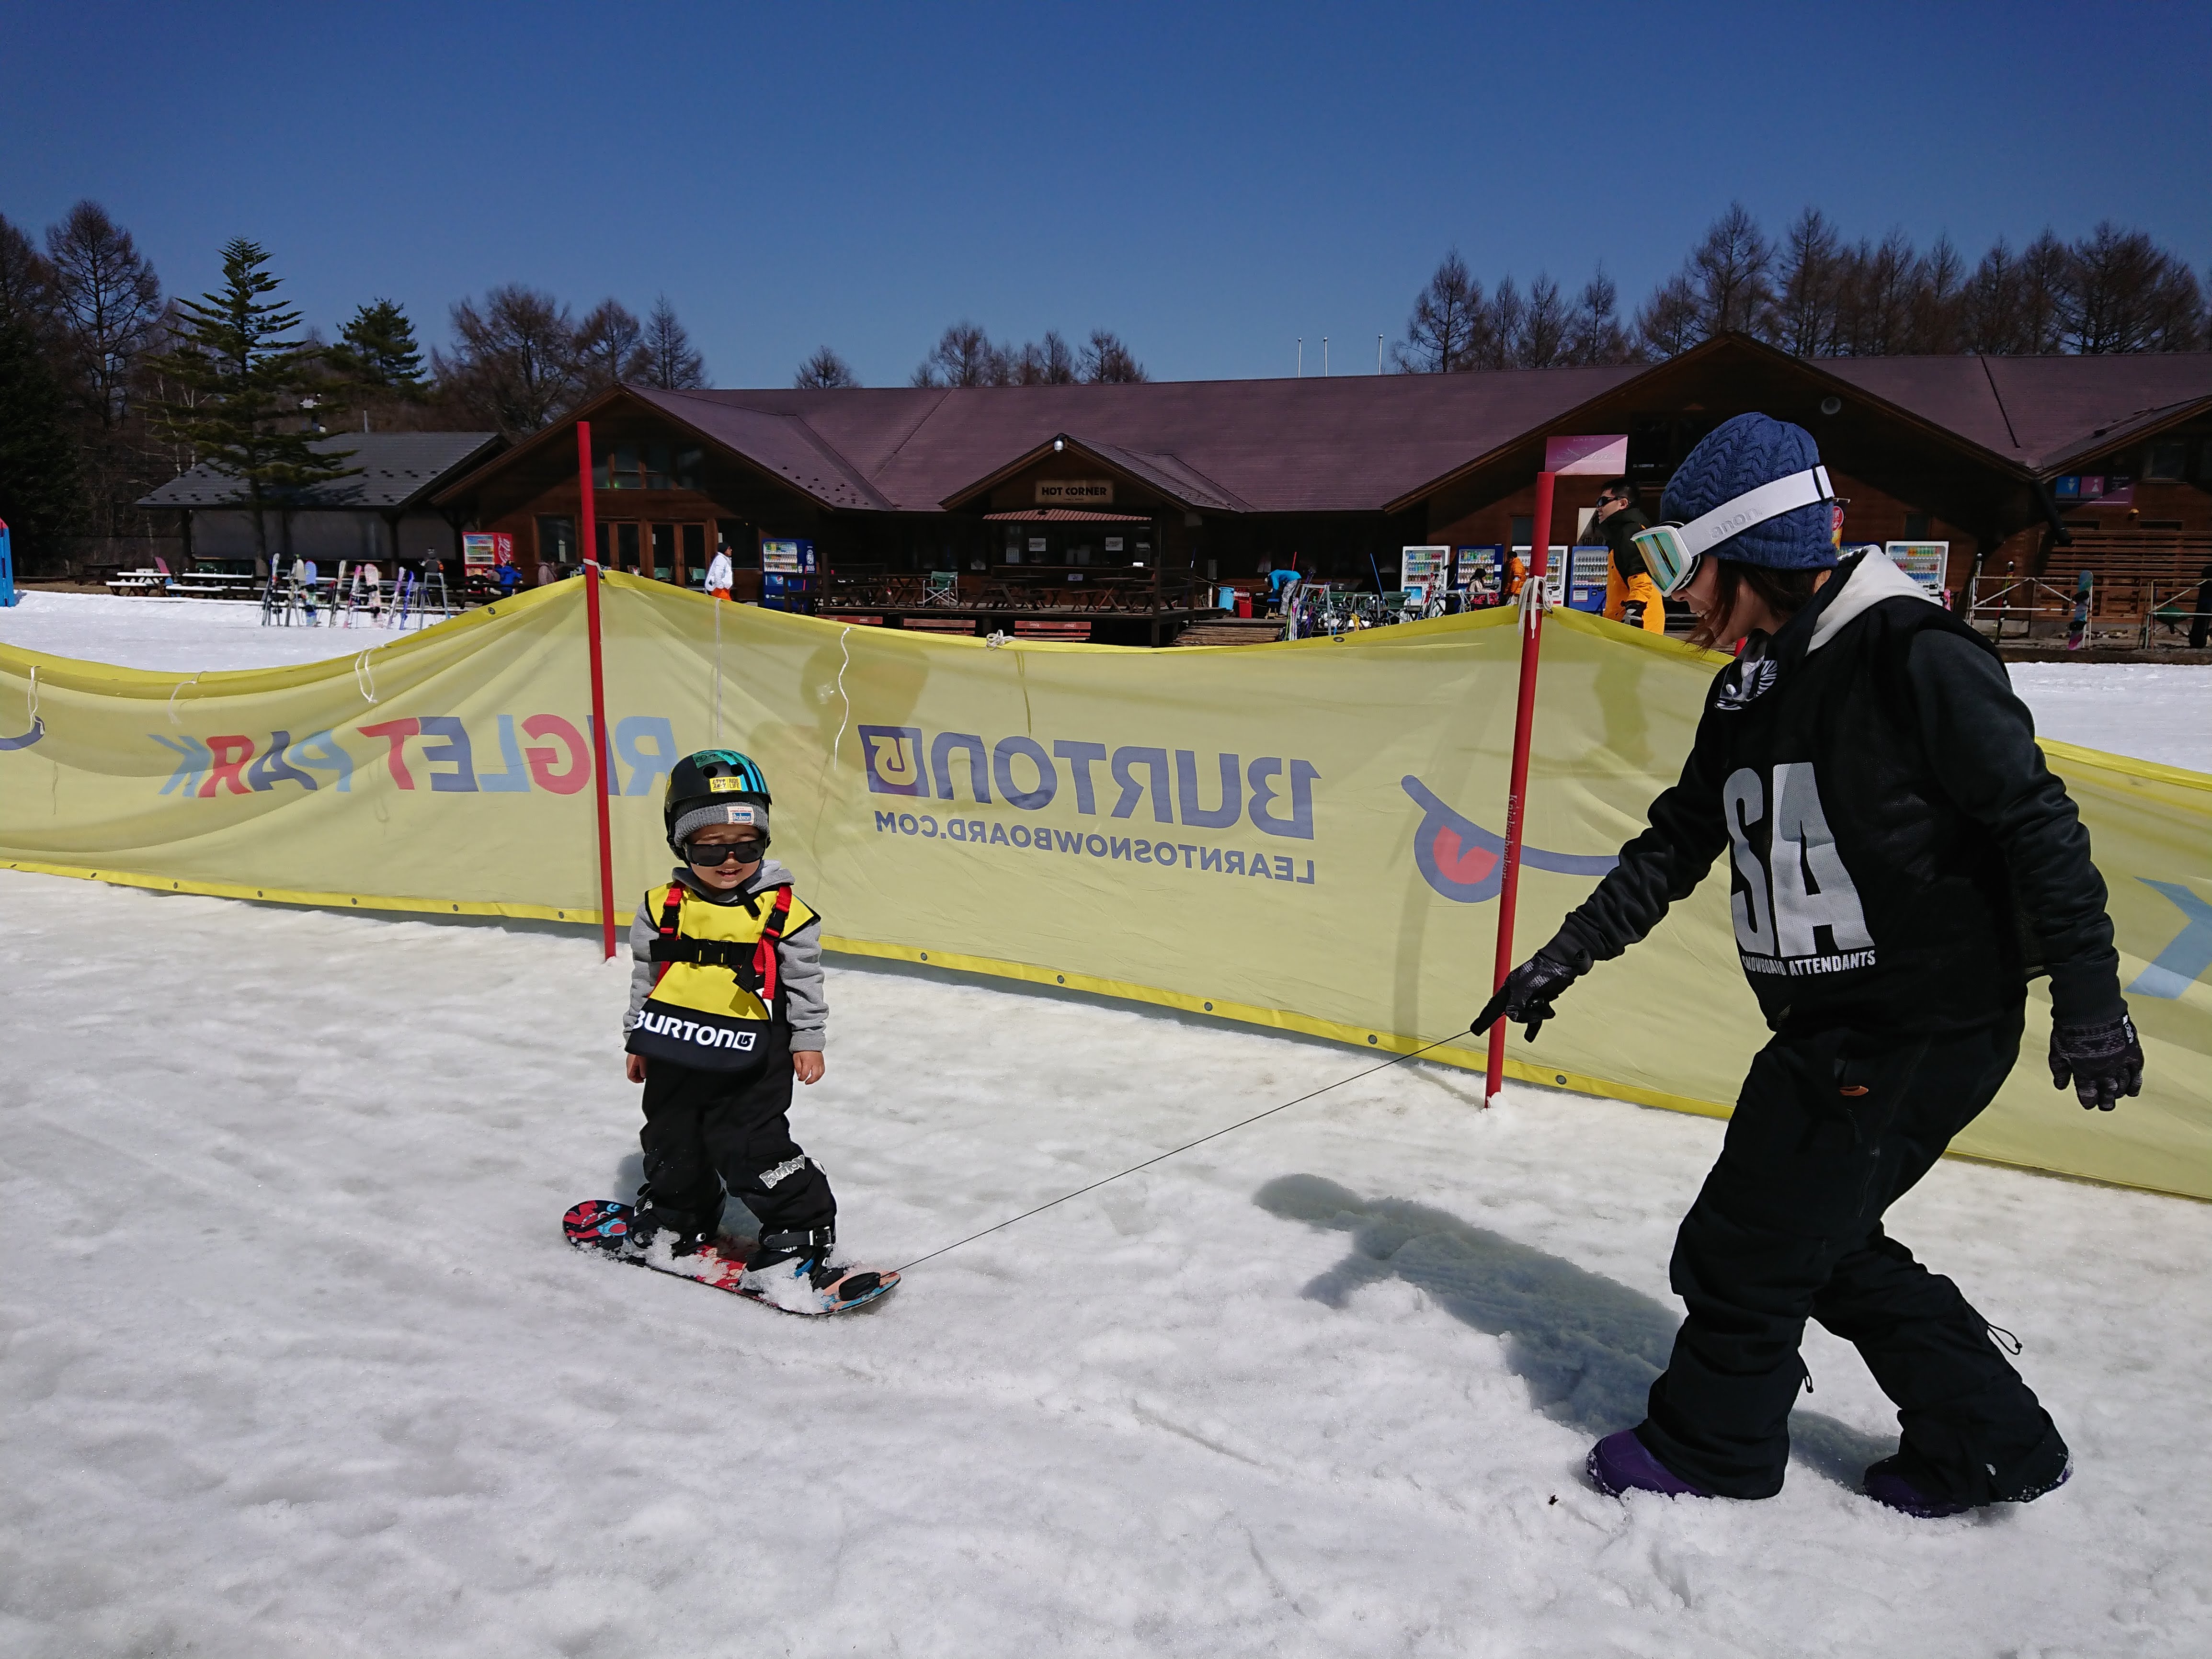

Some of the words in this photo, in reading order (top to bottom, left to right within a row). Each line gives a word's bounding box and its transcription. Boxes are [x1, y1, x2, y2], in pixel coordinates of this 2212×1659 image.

[1042, 487, 1063, 496] HOT
[1065, 487, 1106, 496] CORNER
[1789, 950, 1876, 976] ATTENDANTS
[633, 1010, 735, 1048] BURTON
